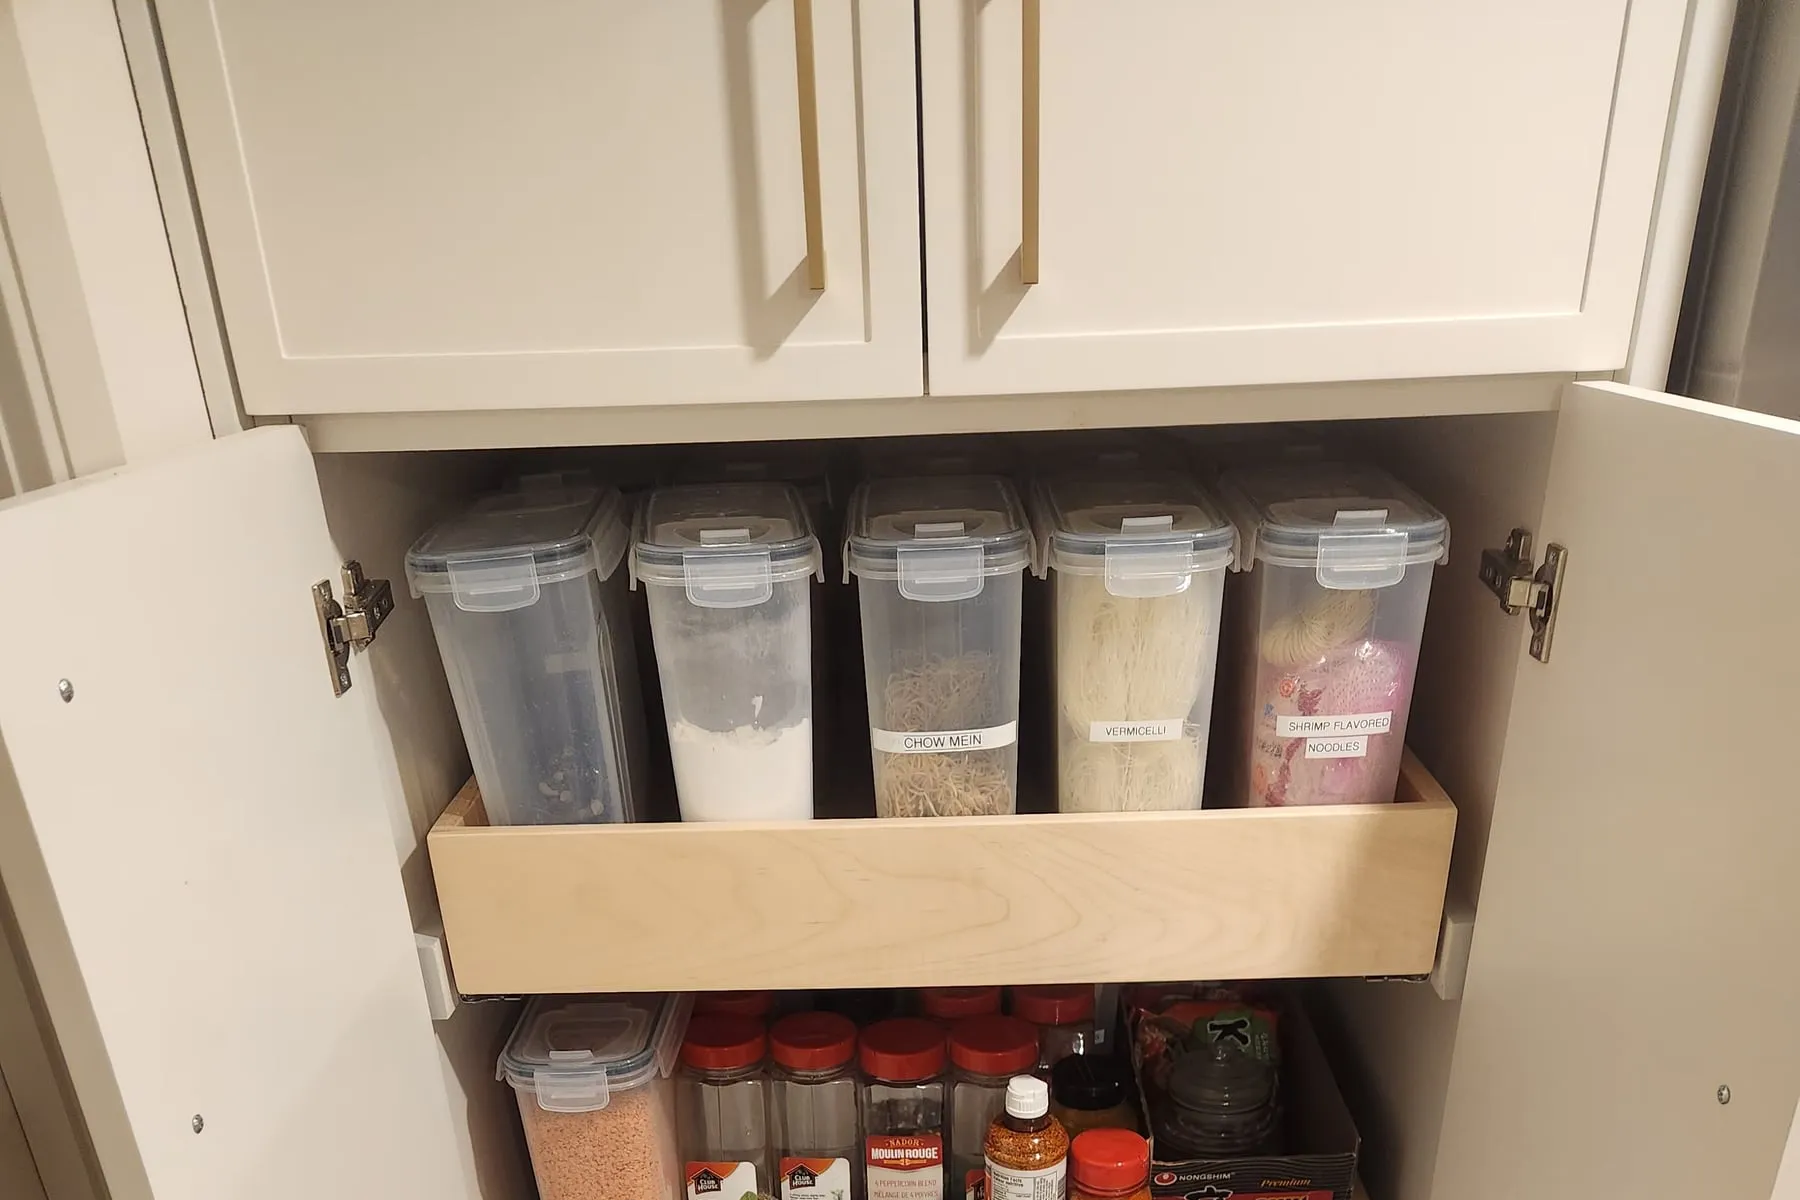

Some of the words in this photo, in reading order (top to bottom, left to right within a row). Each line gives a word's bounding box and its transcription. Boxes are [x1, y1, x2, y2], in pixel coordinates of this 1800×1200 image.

[1288, 721, 1330, 732] SHRIMP
[1333, 717, 1390, 731] FLAVORED
[1105, 726, 1167, 736] VERMICELLI
[904, 735, 946, 749] CHOW
[949, 733, 982, 747] MEIN
[1308, 741, 1360, 753] NOODLES
[889, 1138, 920, 1147] NADOR
[871, 1147, 904, 1160] MOULIN
[905, 1146, 938, 1159] ROUGE
[1179, 1173, 1232, 1181] NONGSHIM
